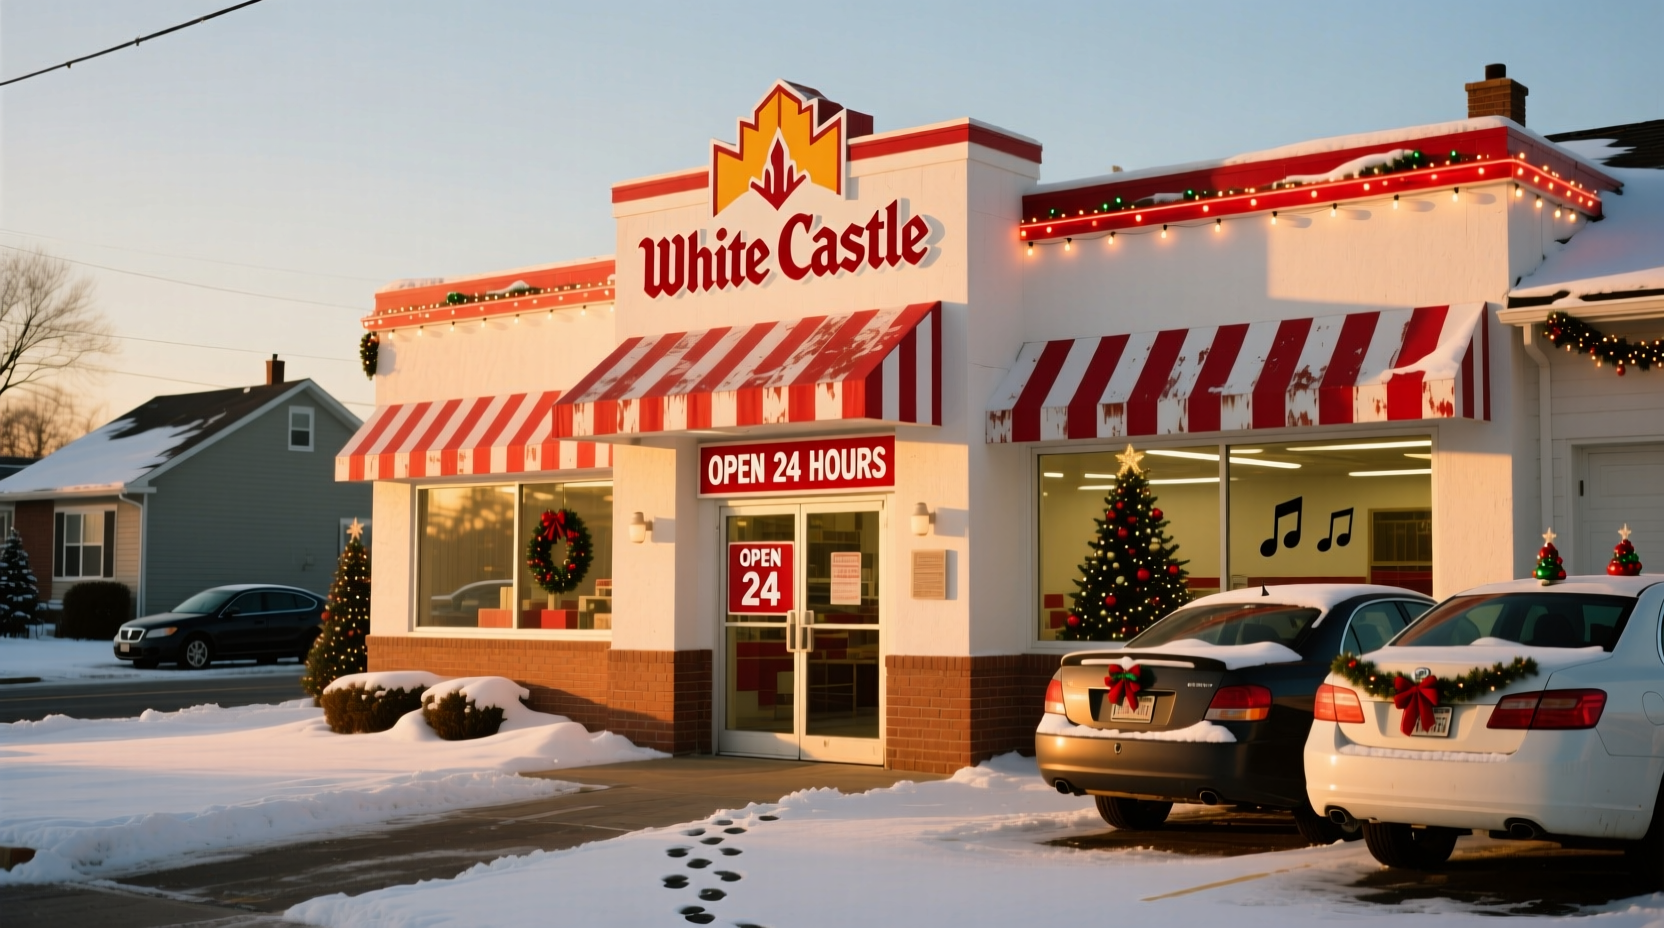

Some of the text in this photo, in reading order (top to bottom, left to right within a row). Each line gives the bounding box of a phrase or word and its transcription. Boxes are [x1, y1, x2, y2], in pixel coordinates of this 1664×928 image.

[638, 199, 929, 298] White Castle
[708, 446, 887, 485] OPEN 24 HOURS
[739, 547, 782, 567] OPEN
[741, 571, 781, 606] 24
